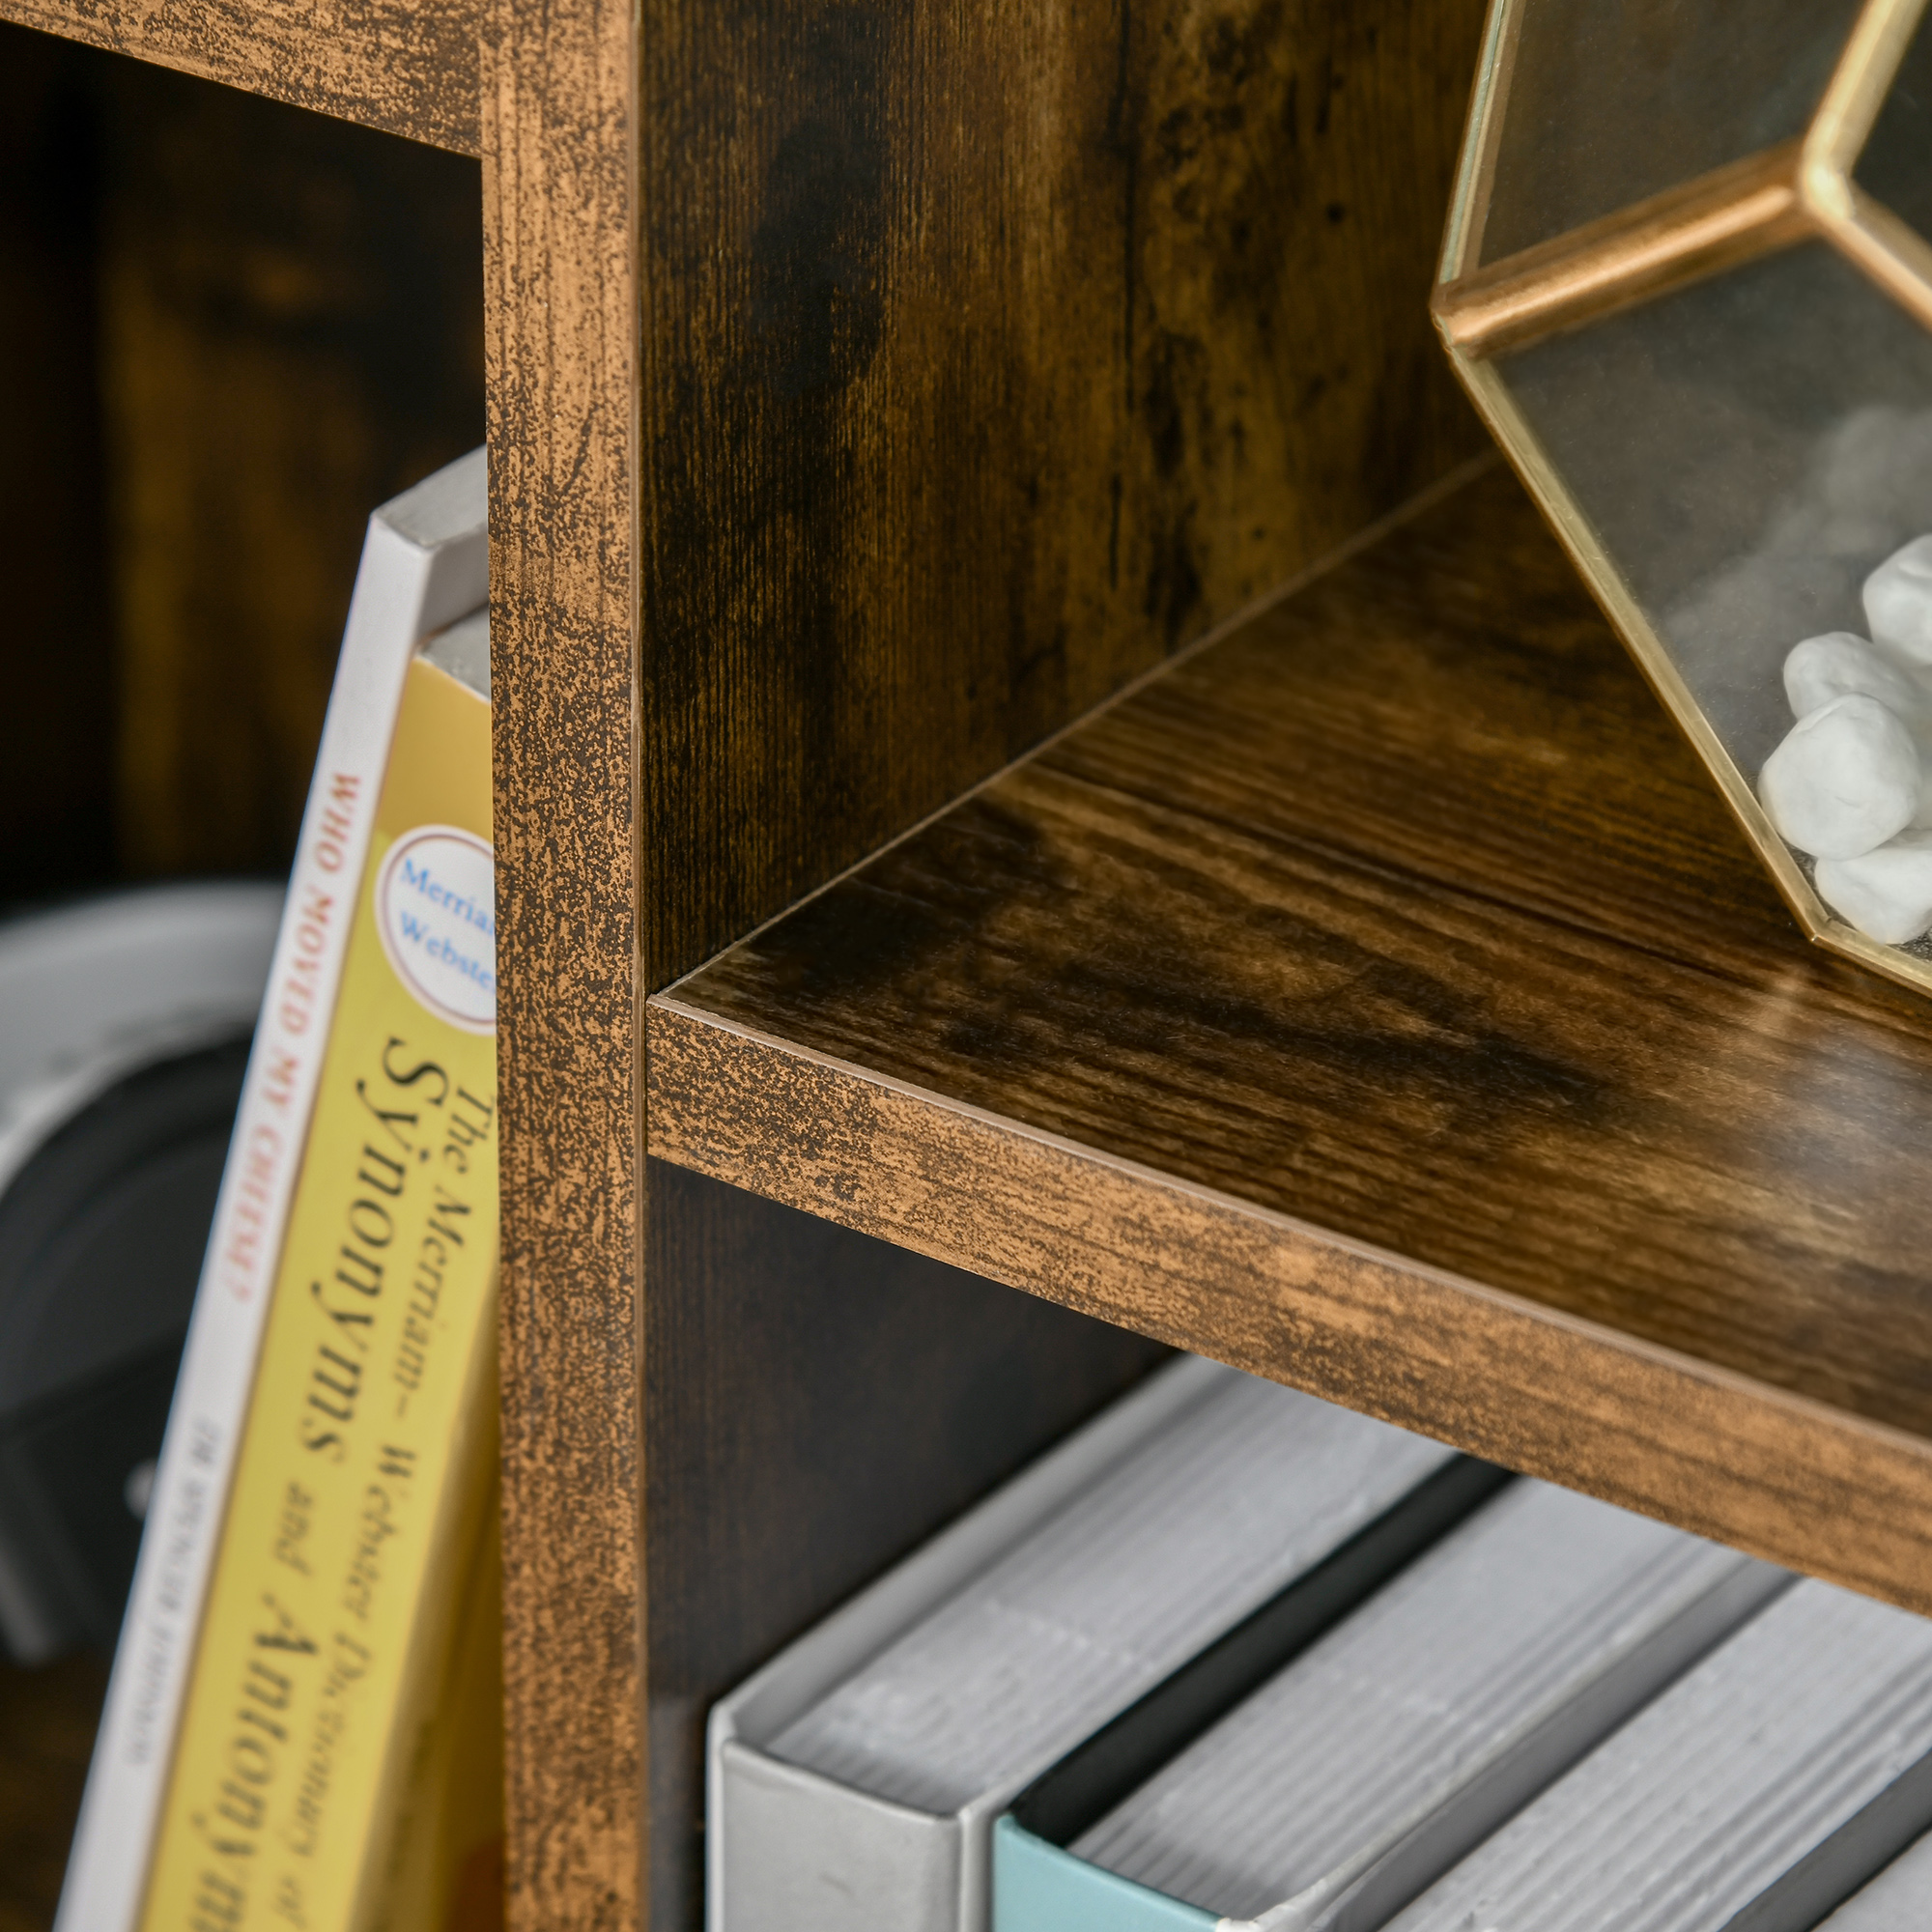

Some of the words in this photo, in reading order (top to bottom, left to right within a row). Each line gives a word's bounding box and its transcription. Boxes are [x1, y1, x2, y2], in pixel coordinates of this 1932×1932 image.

[314, 773, 360, 872] WHO
[400, 857, 494, 937] Merria
[280, 883, 334, 1037] MOVED
[400, 909, 496, 993] Webste
[262, 1042, 300, 1115] MY
[442, 1085, 497, 1175] The
[298, 1036, 451, 1464] Synonyms
[271, 1481, 314, 1577] and
